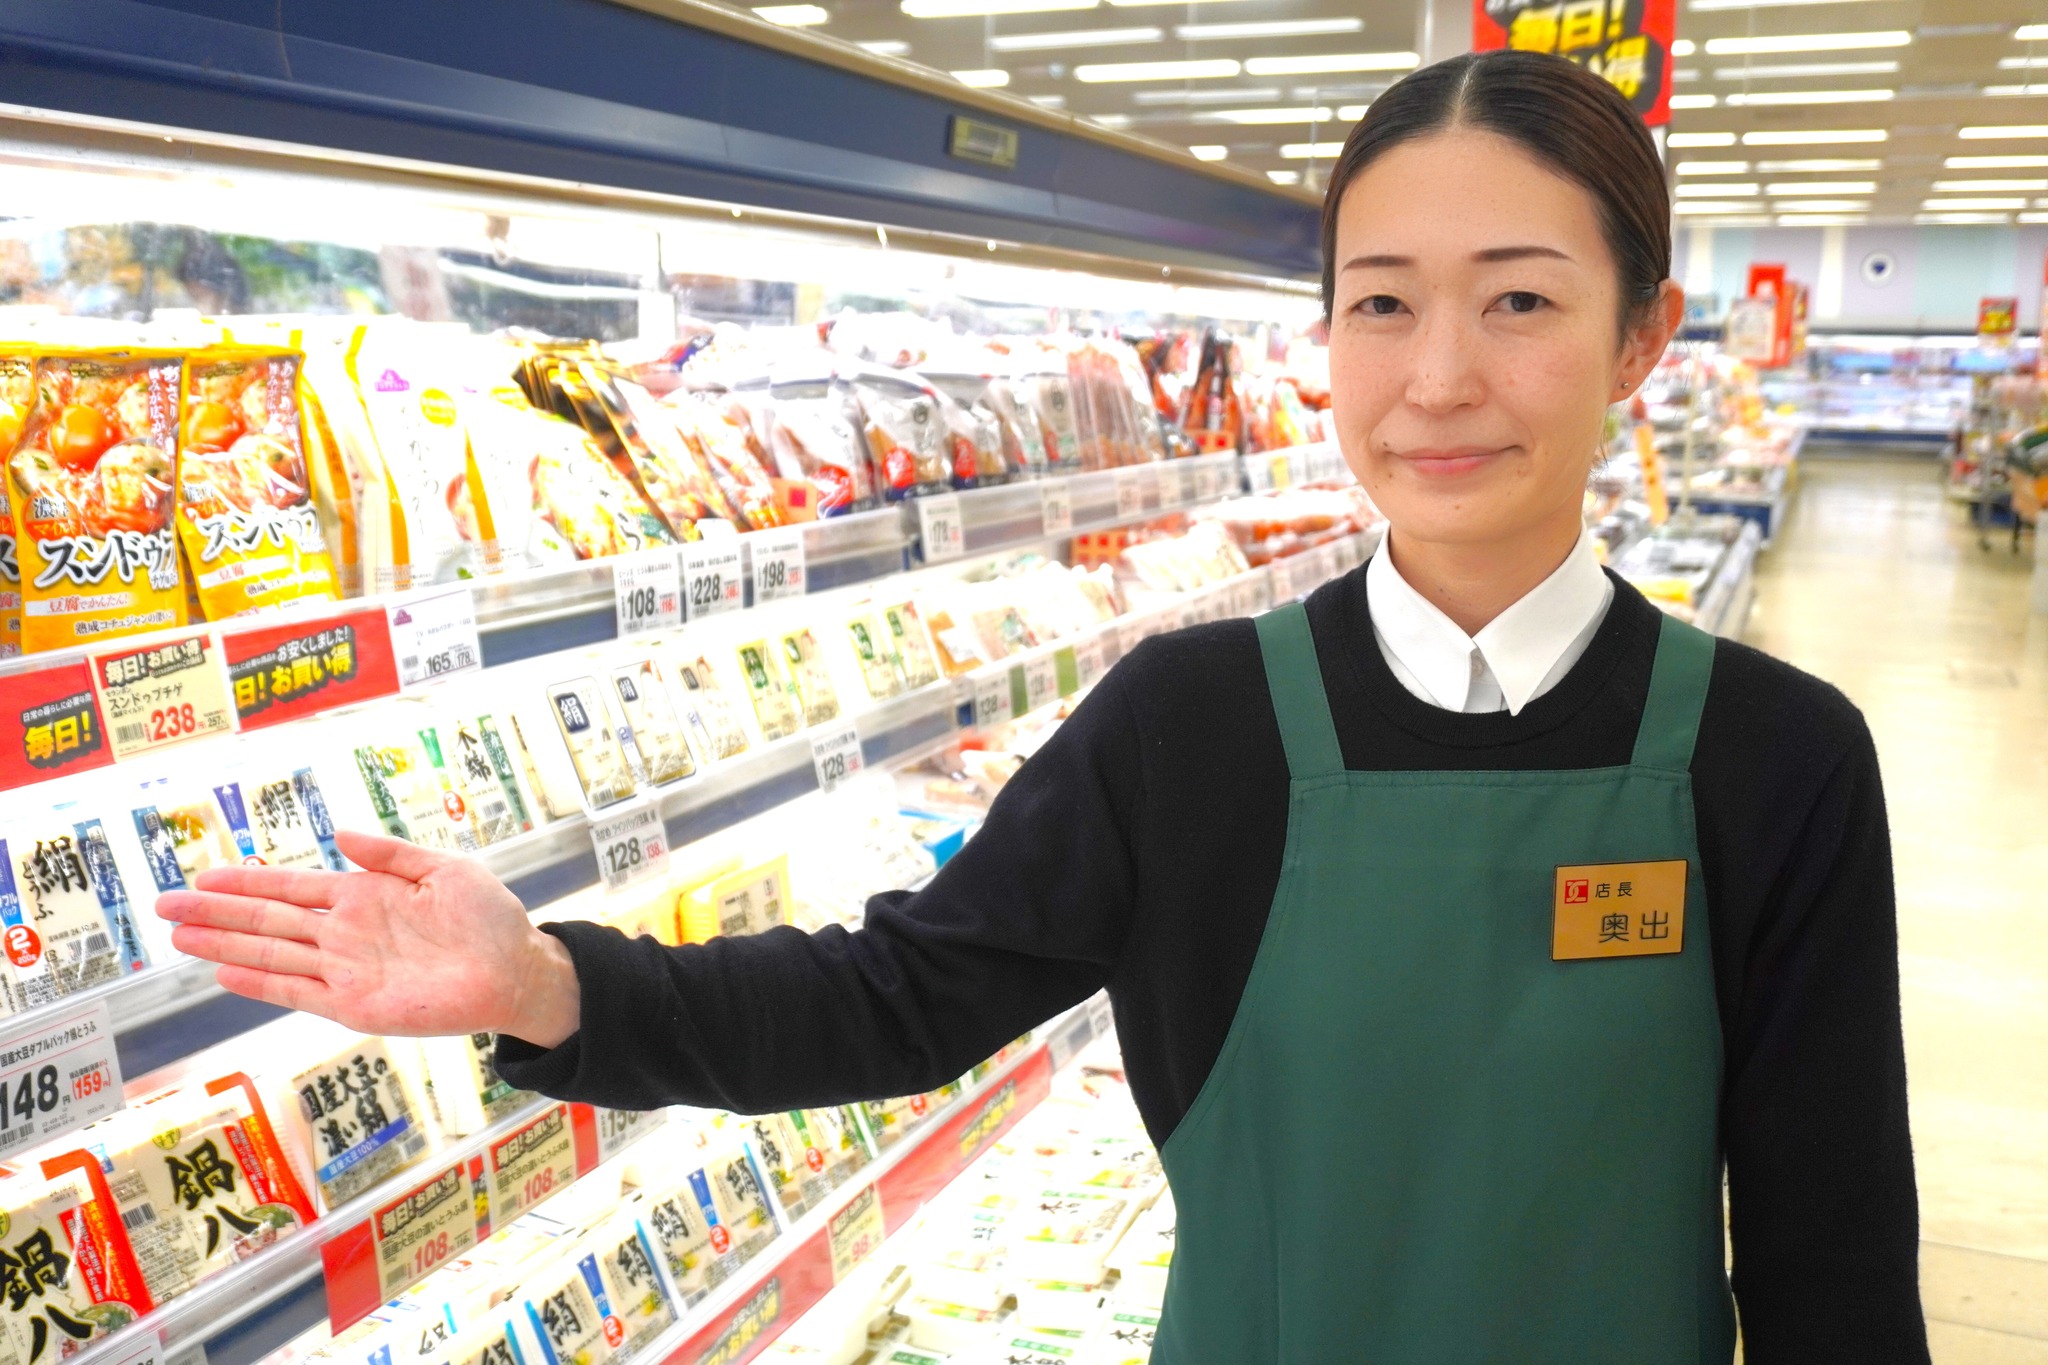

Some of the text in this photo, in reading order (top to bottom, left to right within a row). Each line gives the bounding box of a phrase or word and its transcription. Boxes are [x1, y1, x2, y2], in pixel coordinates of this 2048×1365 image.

[693, 573, 720, 605] 228
[762, 560, 785, 588] 198
[627, 586, 655, 620] 108
[426, 651, 451, 675] 165
[151, 702, 196, 740] 238
[558, 694, 585, 729] 絹
[25, 710, 92, 760] 毎日!
[456, 719, 492, 782] 木綿
[821, 753, 845, 781] 128
[33, 835, 89, 894] 絹
[606, 837, 641, 873] 128
[1595, 882, 1632, 898] 店長
[9, 927, 31, 950] 2
[1598, 910, 1668, 943] 奥出
[0, 1064, 60, 1131] 148
[301, 1054, 388, 1121] 国産大豆の
[328, 1138, 380, 1176] 国産大豆100%
[164, 1138, 263, 1260] 鍋八
[524, 1167, 553, 1204] 108
[415, 1231, 448, 1274] 108
